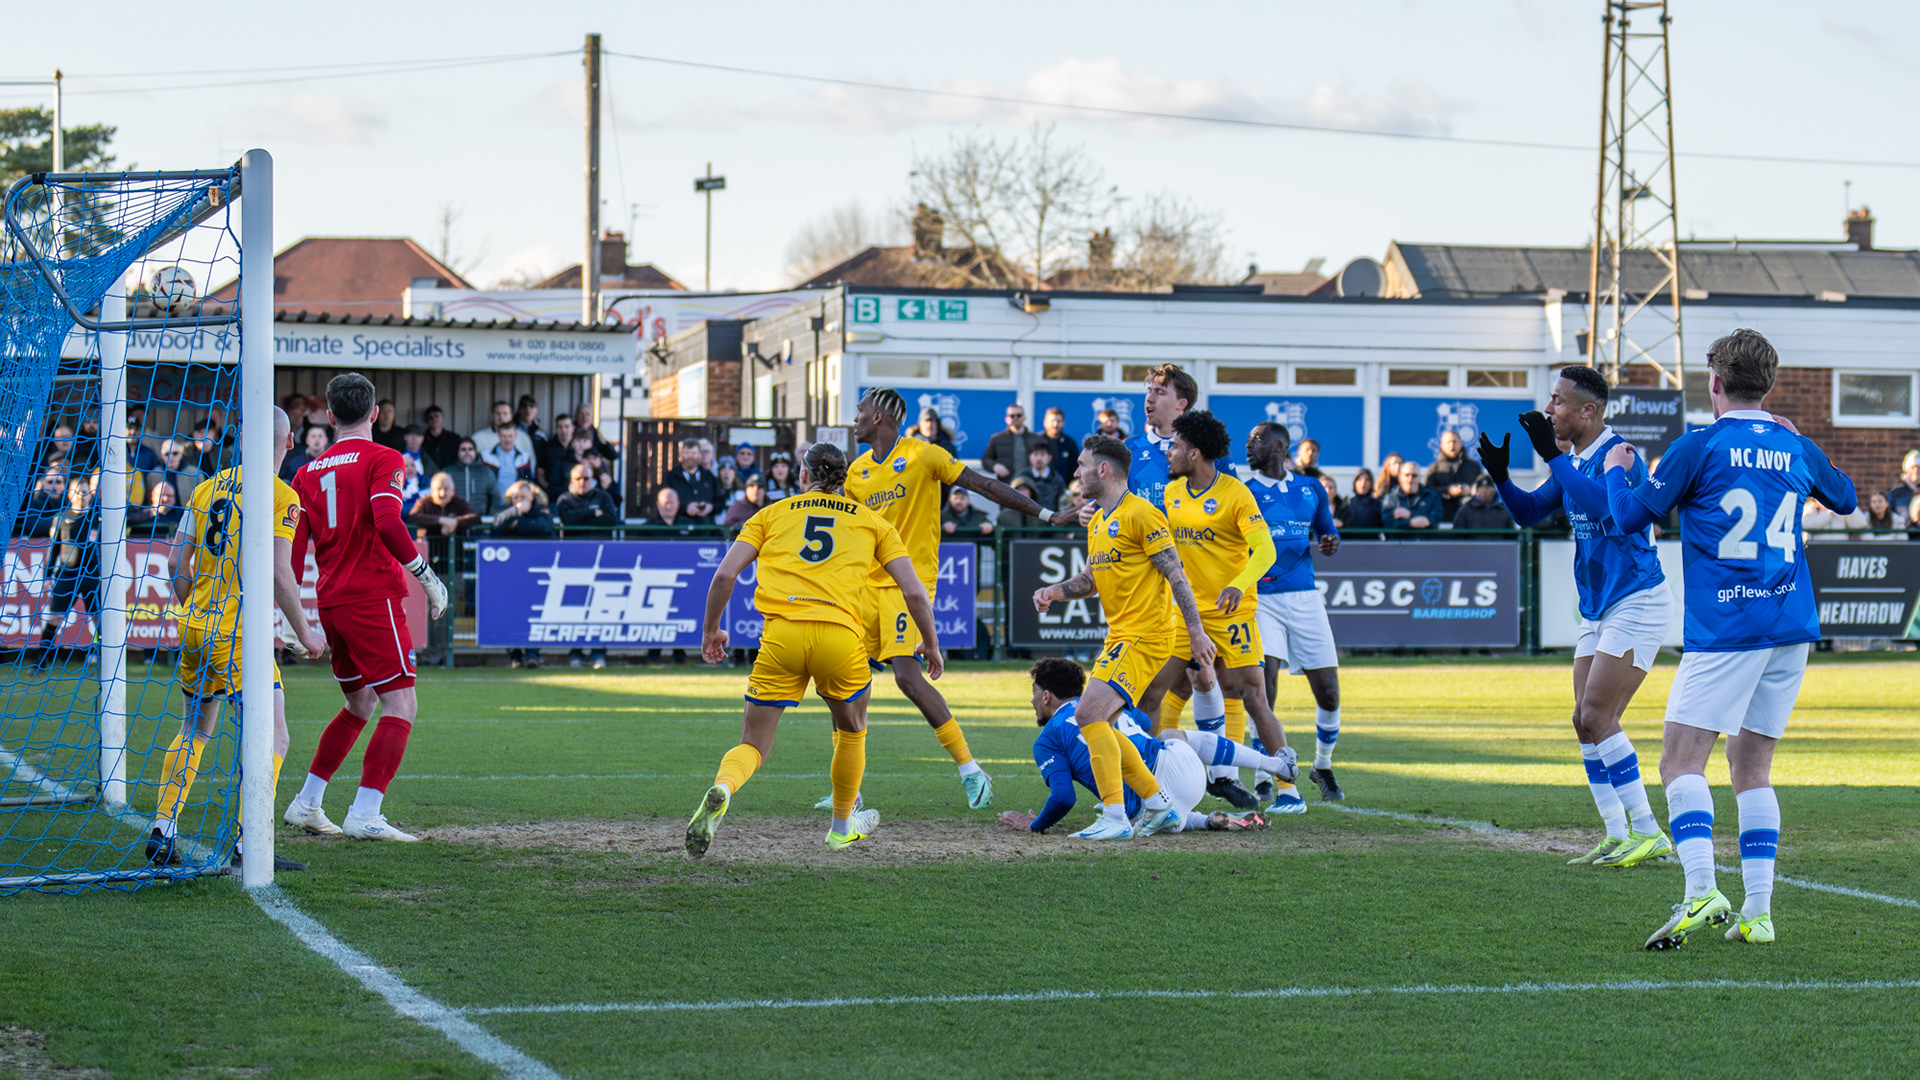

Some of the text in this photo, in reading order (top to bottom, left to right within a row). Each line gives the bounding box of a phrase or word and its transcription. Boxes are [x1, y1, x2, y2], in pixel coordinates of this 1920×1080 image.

[857, 298, 877, 322] B
[944, 301, 965, 310] Fire
[944, 311, 963, 320] exit
[214, 332, 232, 351] &
[273, 330, 343, 355] minate
[353, 333, 466, 361] Specialists
[527, 340, 546, 351] 020
[819, 431, 844, 443] EXIT
[1730, 448, 1792, 472] MC AVOY
[319, 470, 337, 529] 1
[790, 498, 858, 516] FERNANDEZ
[864, 489, 895, 507] utilita
[205, 497, 233, 558] 8
[1717, 487, 1799, 564] 24
[798, 514, 836, 563] 5
[1837, 556, 1889, 579] HAYES
[895, 612, 908, 633] 6
[1412, 608, 1498, 620] BARBERSHOP
[1820, 602, 1905, 625] HEATHROW
[528, 623, 677, 642] SCAFFOLDING
[1227, 622, 1252, 646] 21
[1107, 642, 1124, 661] 4
